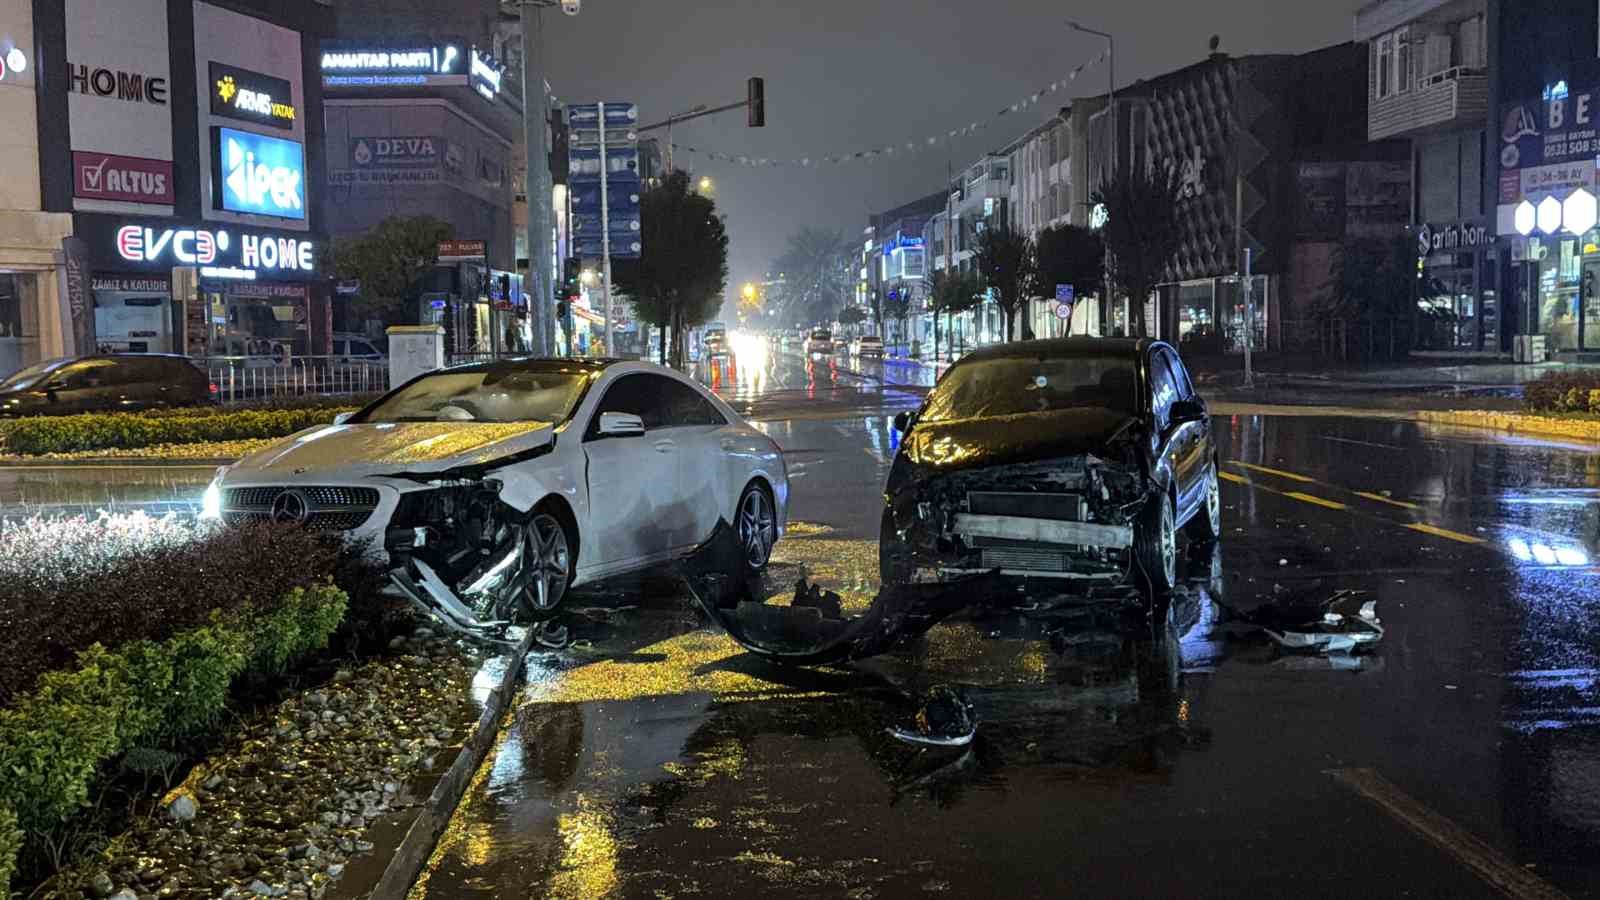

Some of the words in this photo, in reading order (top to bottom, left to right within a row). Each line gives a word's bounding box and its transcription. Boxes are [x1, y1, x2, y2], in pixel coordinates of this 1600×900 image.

[67, 63, 166, 104] HOME
[375, 139, 436, 156] DEVA
[107, 168, 166, 194] ALTUS
[243, 234, 313, 270] HOME
